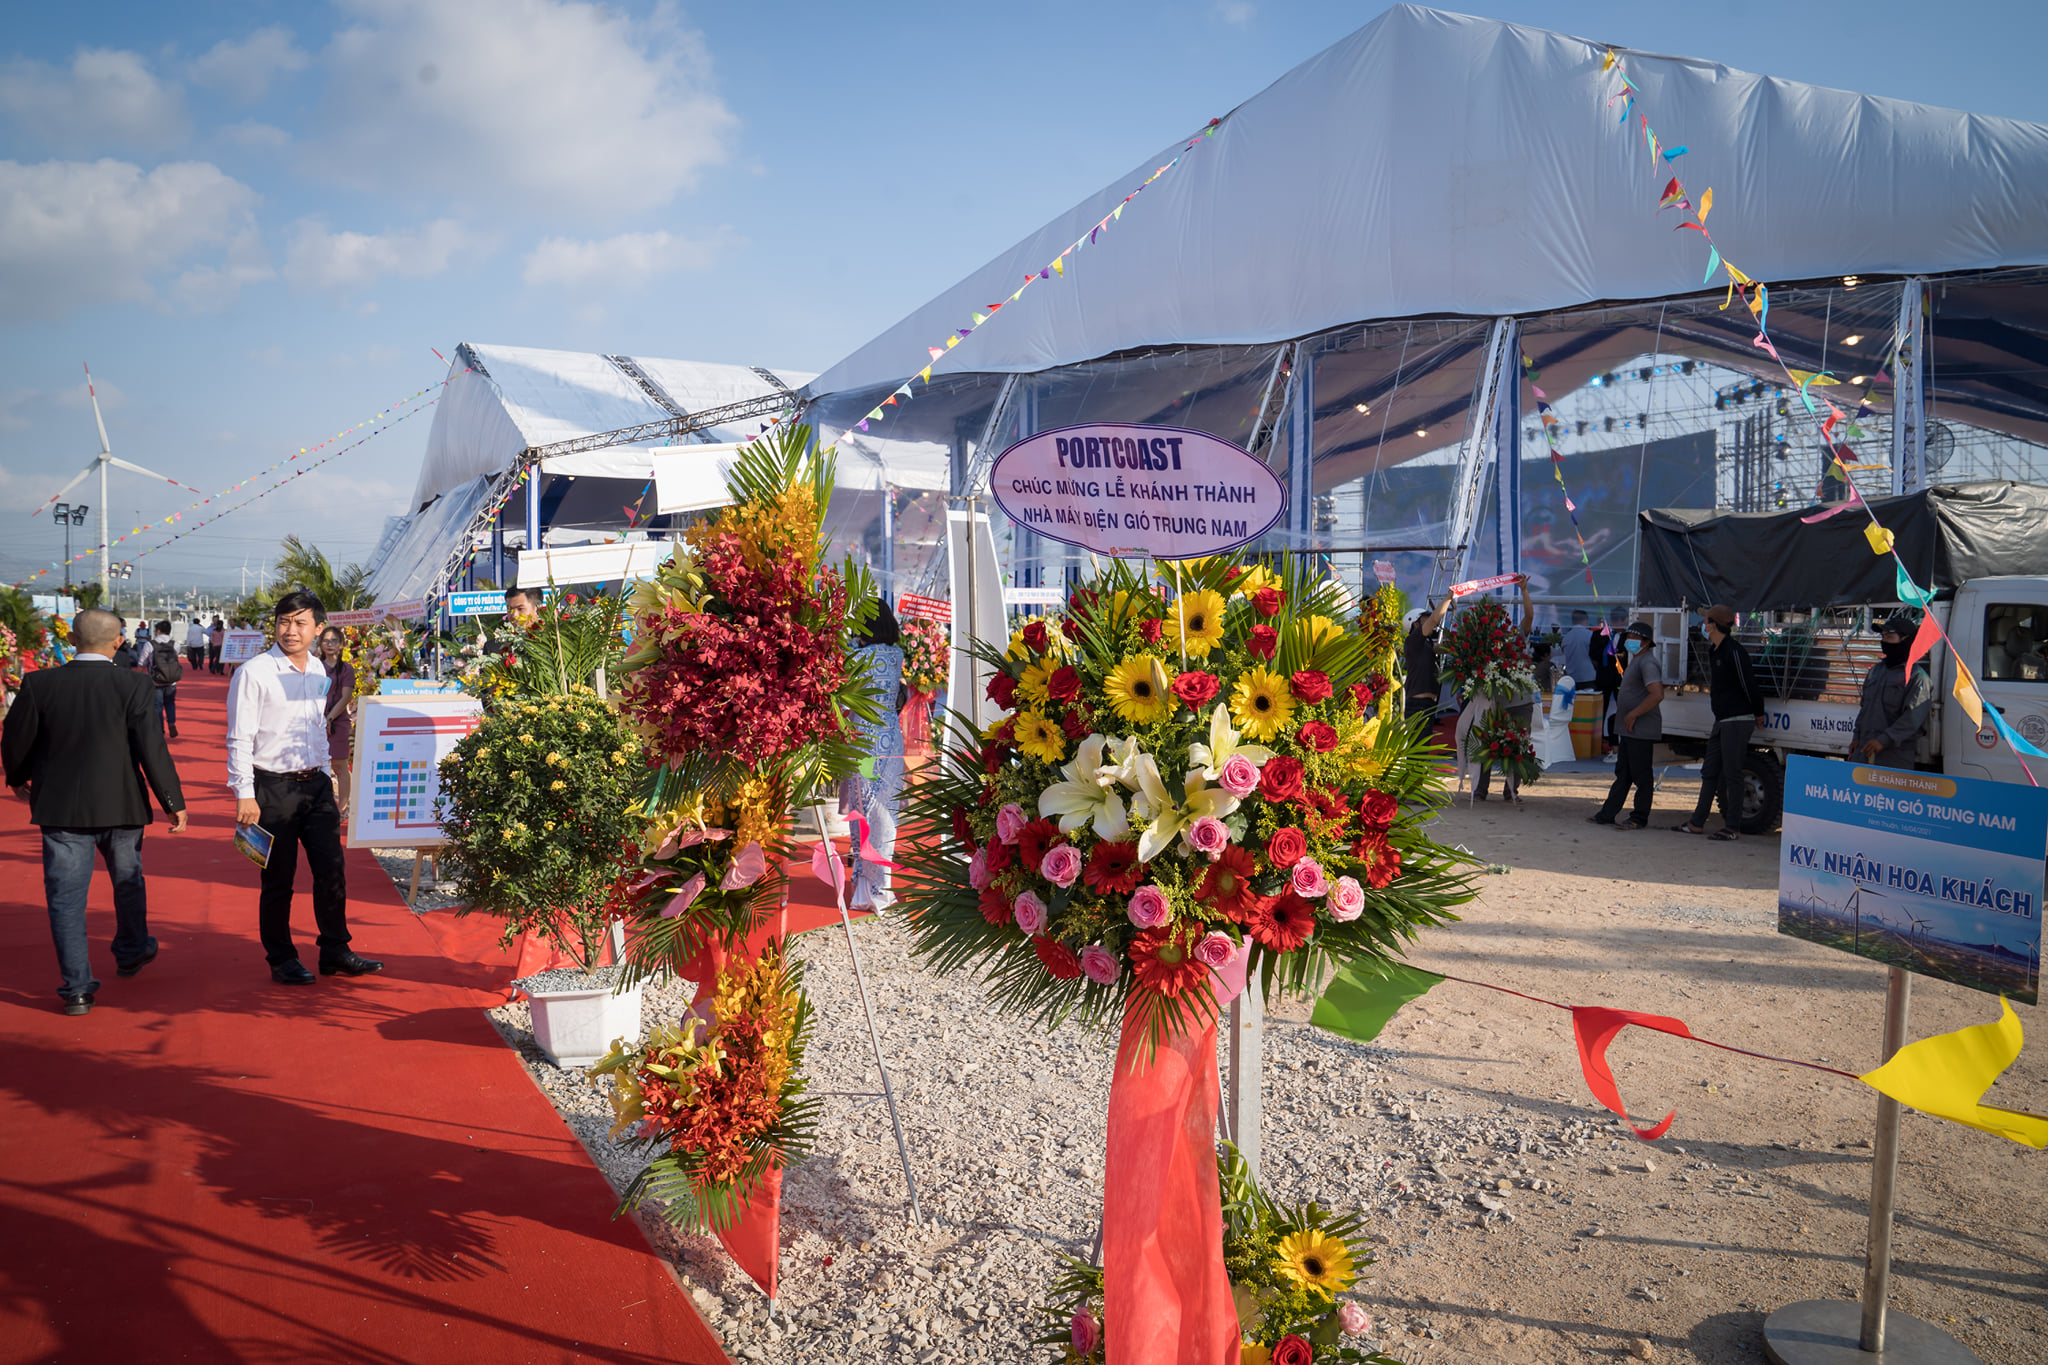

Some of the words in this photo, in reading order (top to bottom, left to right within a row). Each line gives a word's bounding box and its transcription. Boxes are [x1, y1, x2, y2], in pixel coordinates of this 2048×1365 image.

[1056, 437, 1183, 470] PORTCOAST
[1012, 477, 1052, 495] CHÚC
[1056, 477, 1100, 497] MỪNG
[1105, 475, 1126, 498] LỄ
[1130, 480, 1189, 501] KHÁNH
[1194, 481, 1256, 503] THÀNH
[1023, 504, 1053, 523] NHÀ
[1055, 505, 1081, 525] MÁY
[1083, 508, 1119, 532] ĐIỆN
[1124, 510, 1150, 531] GIÓ
[1152, 515, 1207, 535] TRUNG
[1211, 519, 1248, 538] NAM
[1810, 716, 1835, 733] NHẬN
[1868, 770, 1877, 782] LỄ
[1879, 774, 1907, 787] KHÁNH
[1908, 778, 1938, 791] THÀNH
[1805, 784, 1829, 800] NHÀ
[1832, 787, 1861, 805] MÁY
[1864, 793, 1895, 812] ĐIỆN
[1897, 799, 1923, 815] GIÓ
[1926, 803, 1975, 824] TRUNG
[1979, 813, 2016, 831] NAM
[1789, 844, 1818, 870] KV.
[1823, 850, 1882, 885] NHẬN
[1887, 864, 1936, 897] HOA
[1940, 876, 2033, 918] KHÁCH
